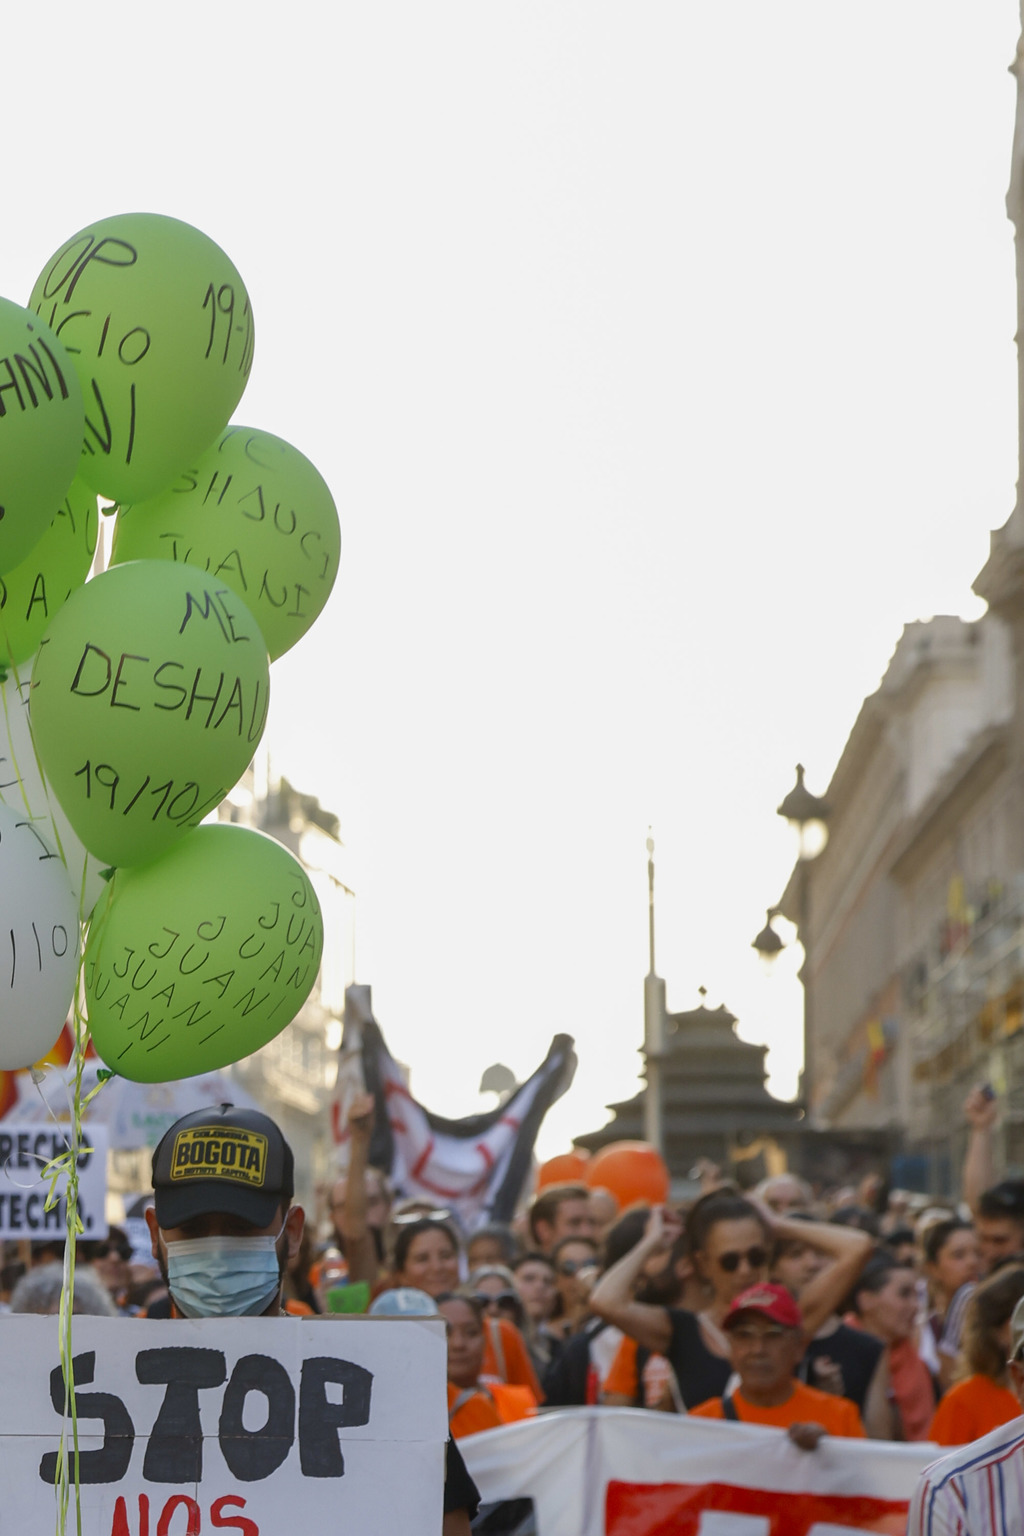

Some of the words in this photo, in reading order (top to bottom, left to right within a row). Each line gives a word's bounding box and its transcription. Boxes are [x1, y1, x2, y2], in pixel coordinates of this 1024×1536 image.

[179, 588, 250, 644] ME
[176, 1140, 261, 1173] BOGOTA
[192, 1130, 250, 1142] COLOMBIA
[39, 1345, 374, 1485] STOP
